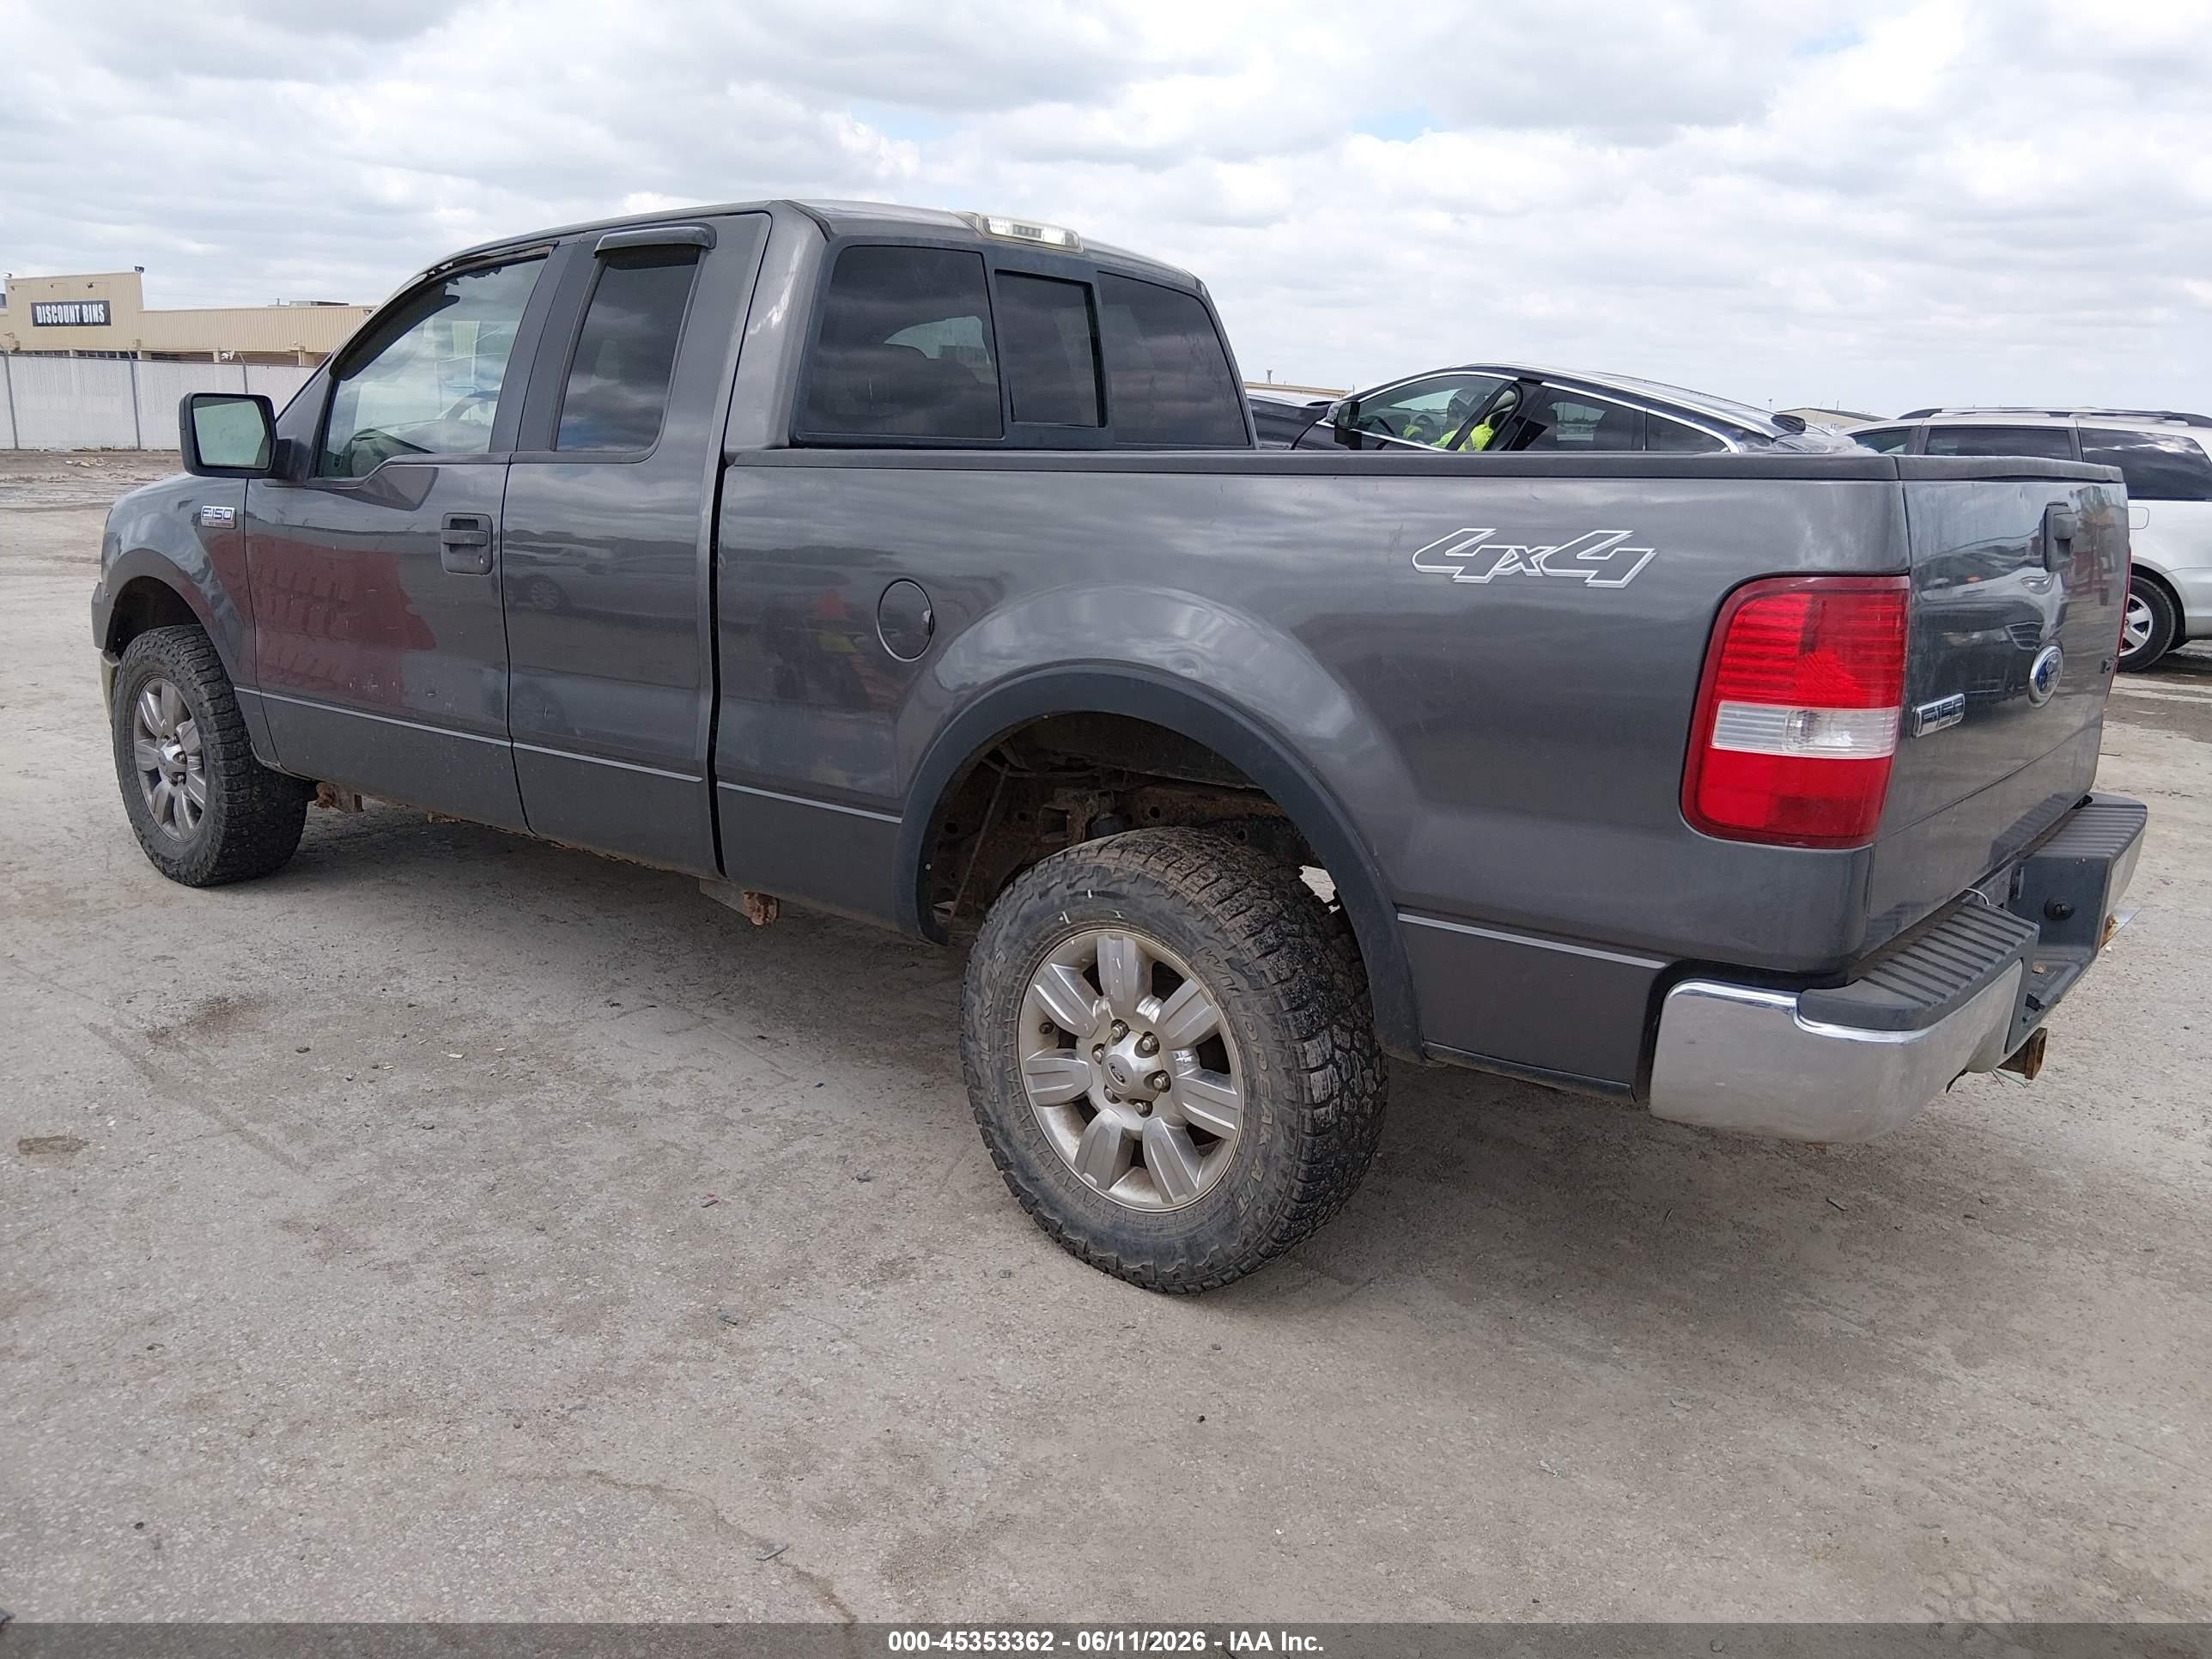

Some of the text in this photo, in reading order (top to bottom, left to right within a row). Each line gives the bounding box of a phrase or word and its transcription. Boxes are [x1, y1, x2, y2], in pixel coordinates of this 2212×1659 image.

[36, 303, 105, 324] DISCOUNT BINS
[1413, 528, 1656, 588] 4x4
